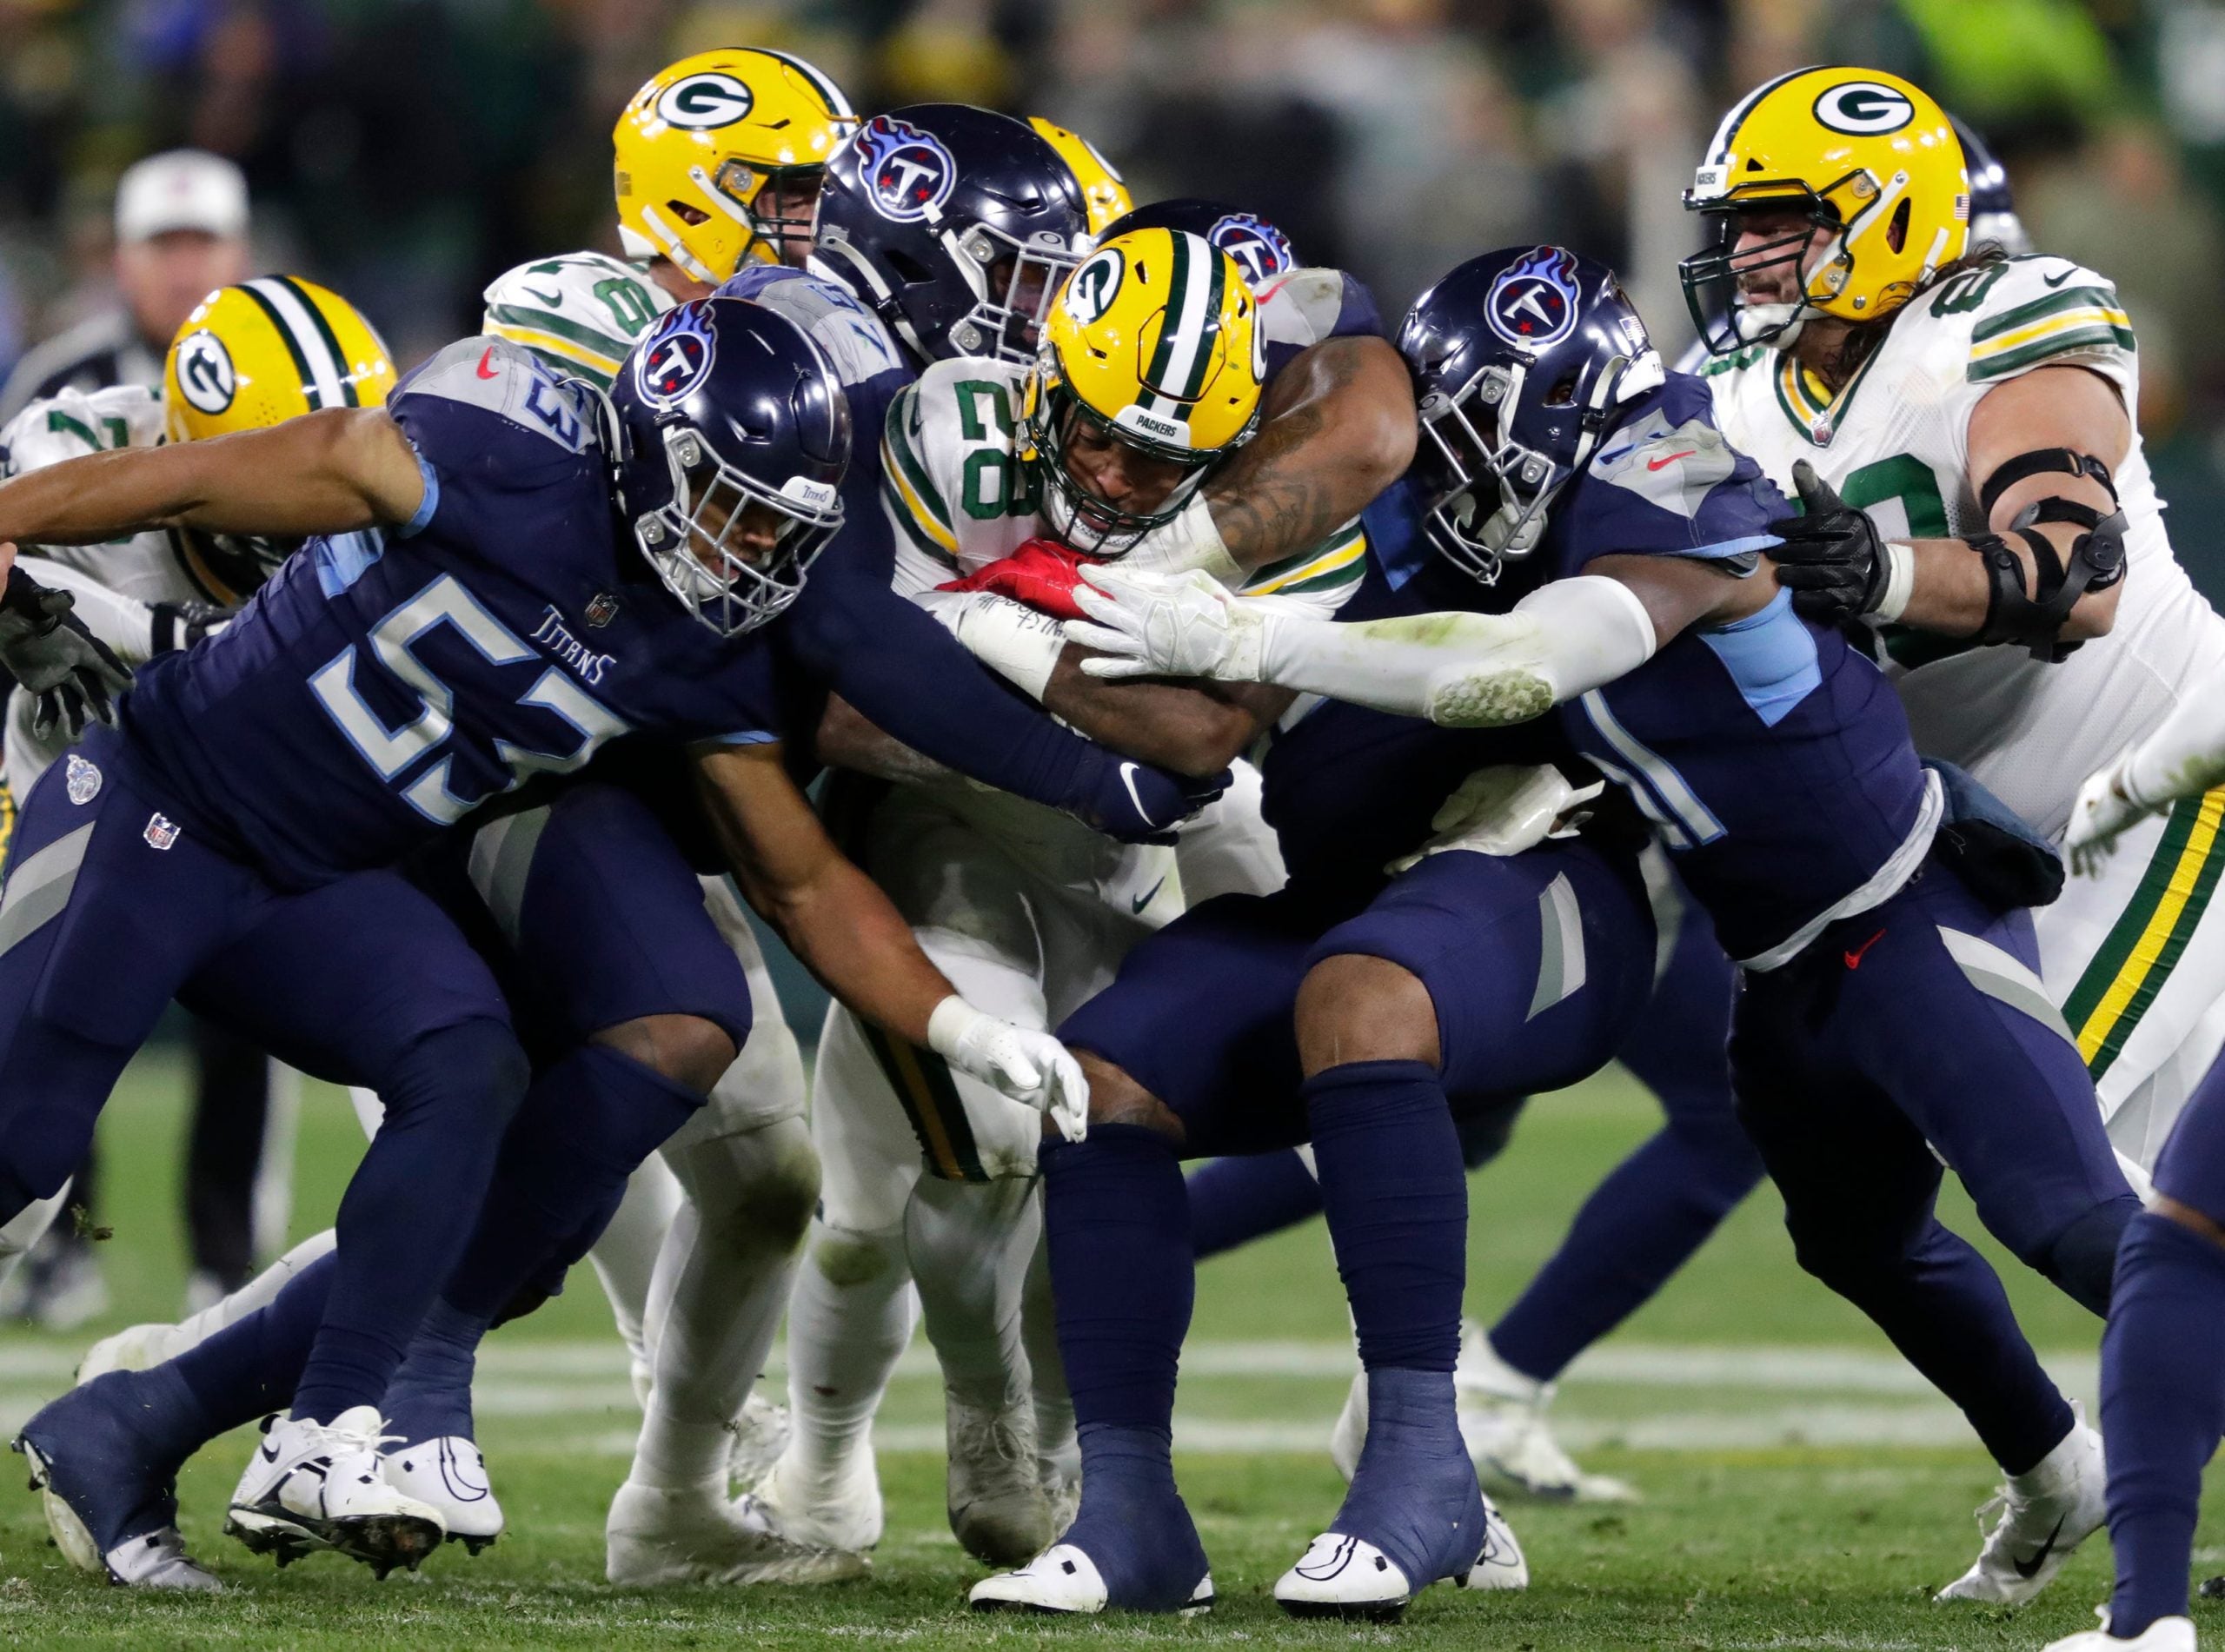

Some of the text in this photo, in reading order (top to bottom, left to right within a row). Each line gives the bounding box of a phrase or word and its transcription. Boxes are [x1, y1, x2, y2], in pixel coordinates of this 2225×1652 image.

[655, 71, 754, 132] G
[1811, 81, 1916, 137] G
[953, 379, 1040, 521] 28
[1135, 415, 1178, 437] PACKERS
[529, 603, 618, 686] TITANS
[307, 572, 631, 826] 53
